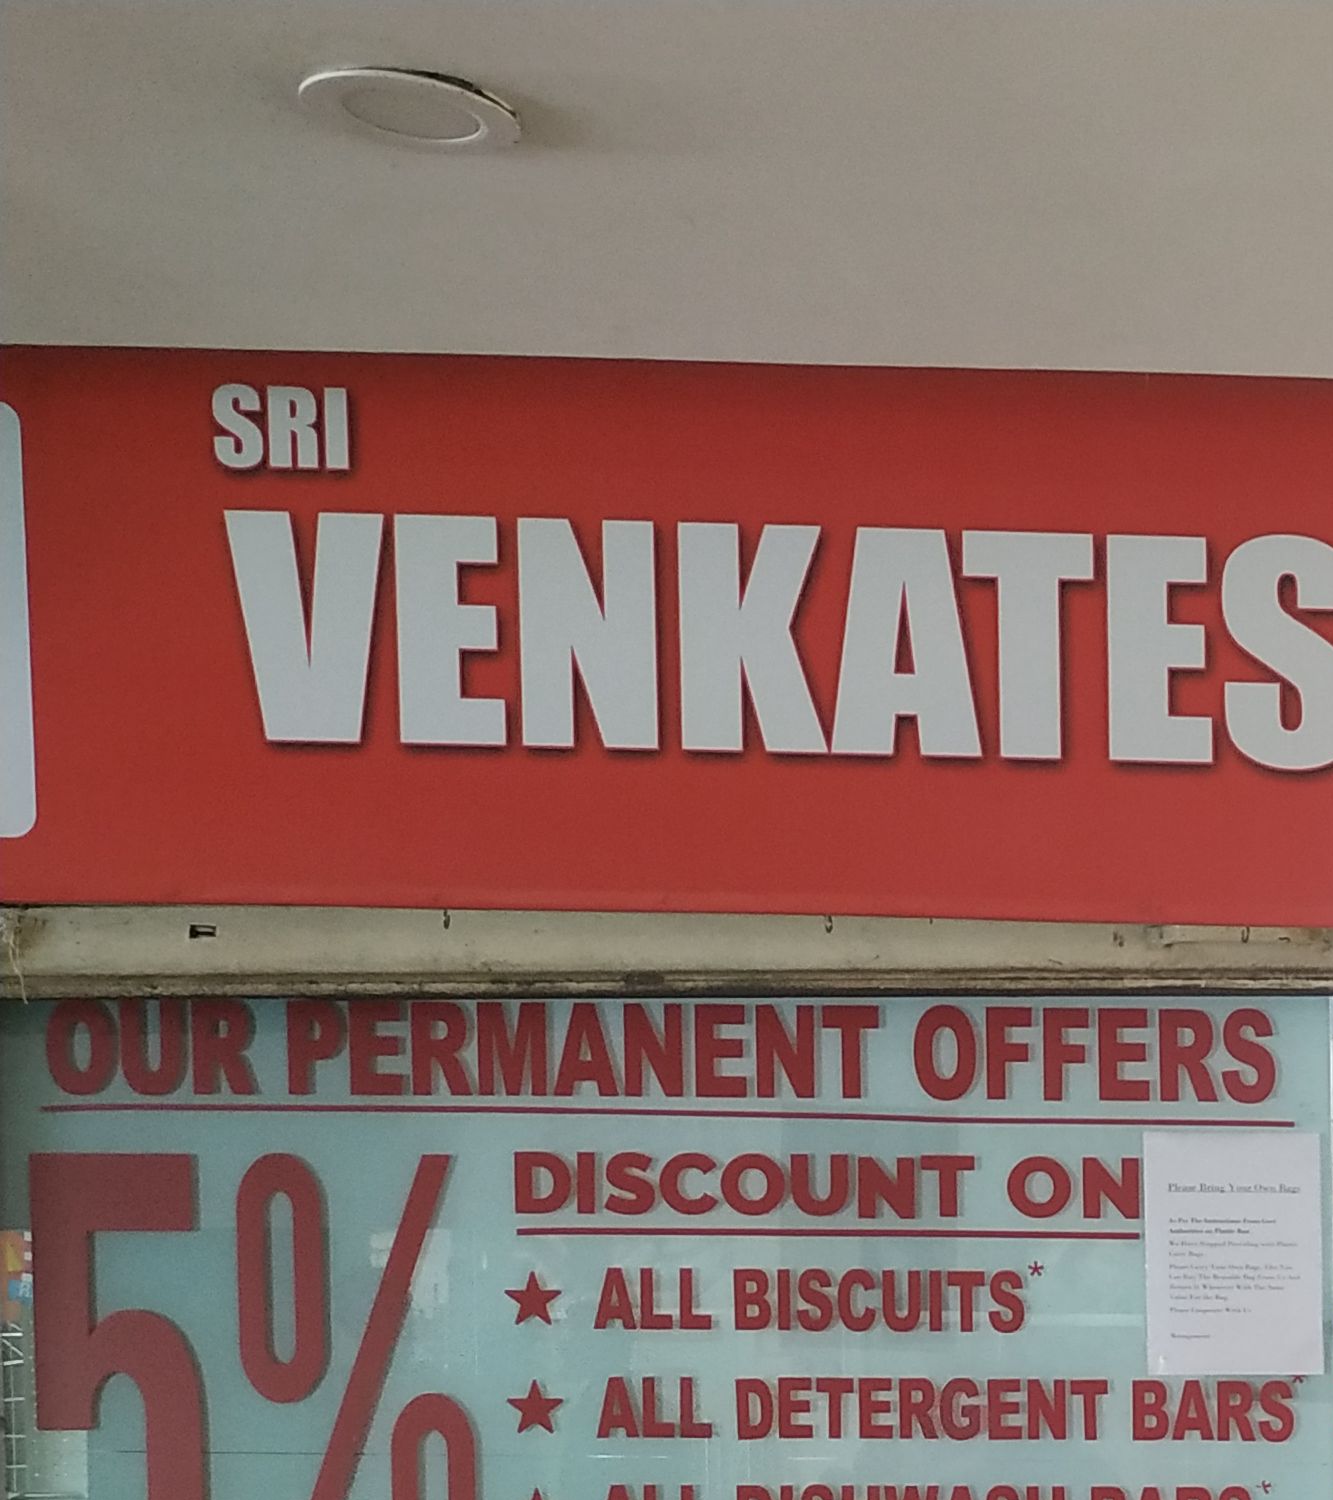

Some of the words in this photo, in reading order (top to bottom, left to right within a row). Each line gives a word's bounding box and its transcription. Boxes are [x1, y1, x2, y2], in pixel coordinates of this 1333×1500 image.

[213, 386, 348, 468] SRI
[48, 1004, 251, 1094] OUR
[288, 1003, 879, 1098] PERMANENT
[915, 1006, 1275, 1103] OFFERS
[515, 1152, 974, 1218] DISCOUNT
[1008, 1157, 1139, 1218] ON
[595, 1268, 711, 1328] ALL
[599, 1377, 711, 1437] ALL
[736, 1378, 1107, 1440] DETERGENT
